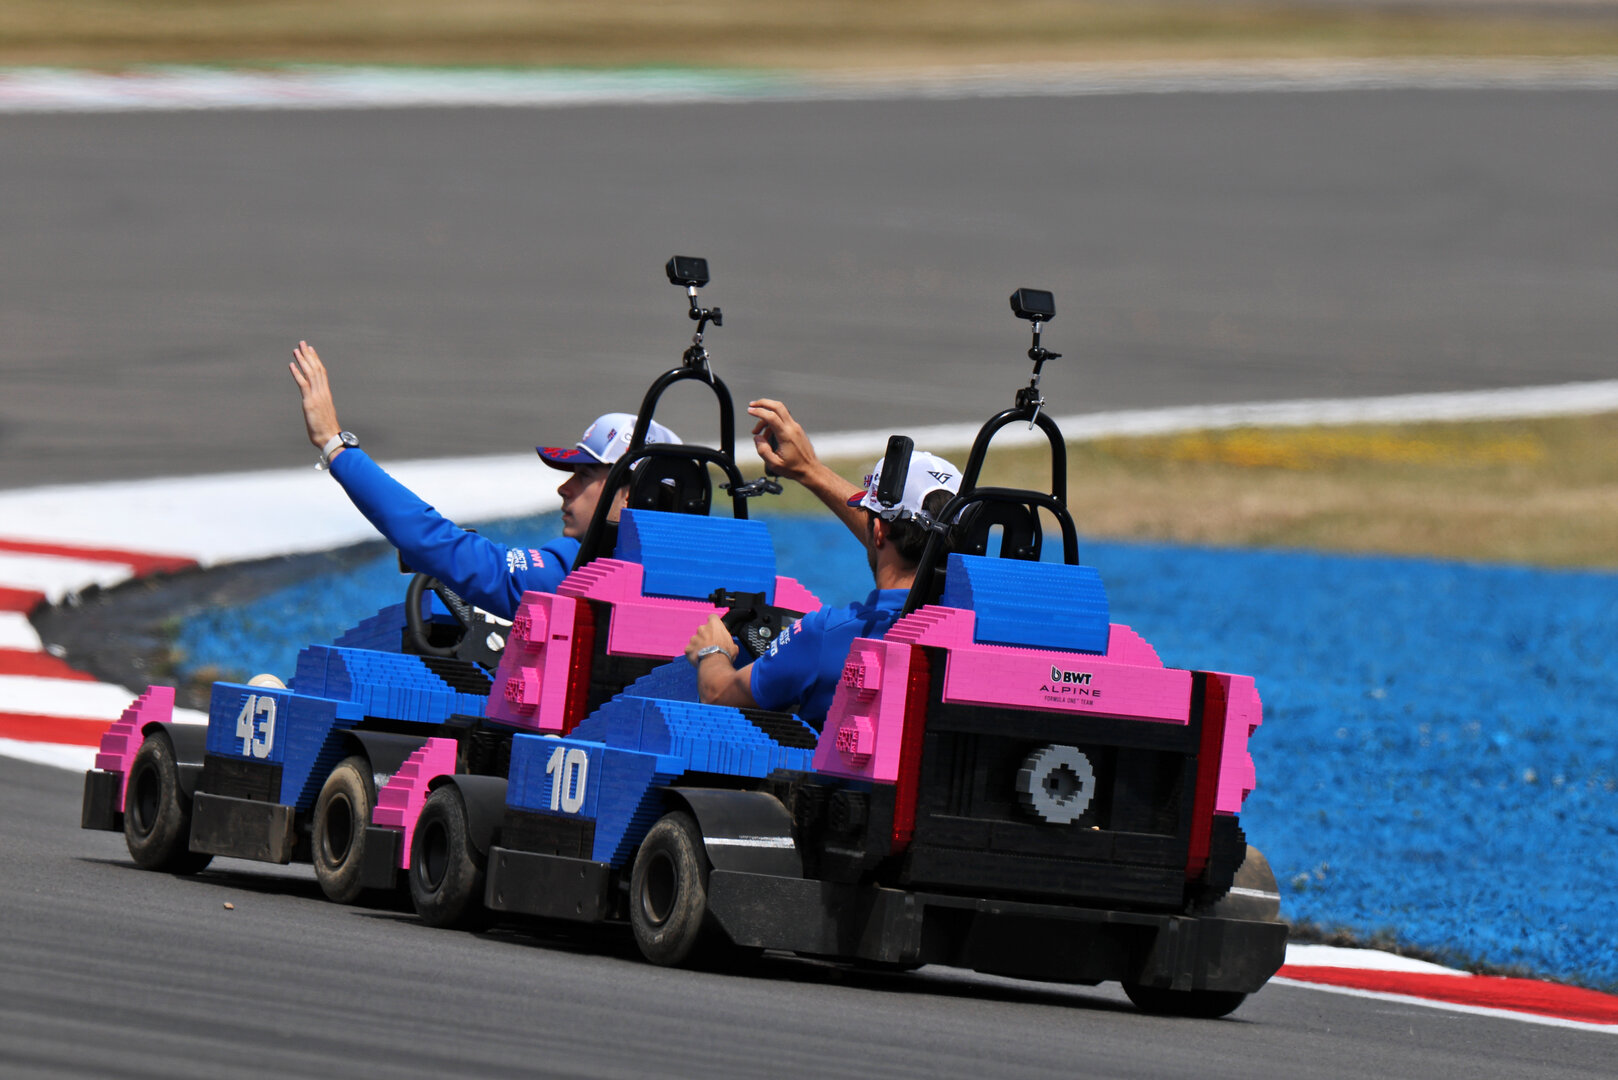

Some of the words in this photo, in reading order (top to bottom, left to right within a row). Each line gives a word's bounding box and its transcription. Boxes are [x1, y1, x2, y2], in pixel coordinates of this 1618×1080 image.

[1039, 685, 1101, 697] ALPINE
[1062, 671, 1092, 685] BWT
[235, 694, 276, 759] 43
[546, 746, 588, 813] 10
